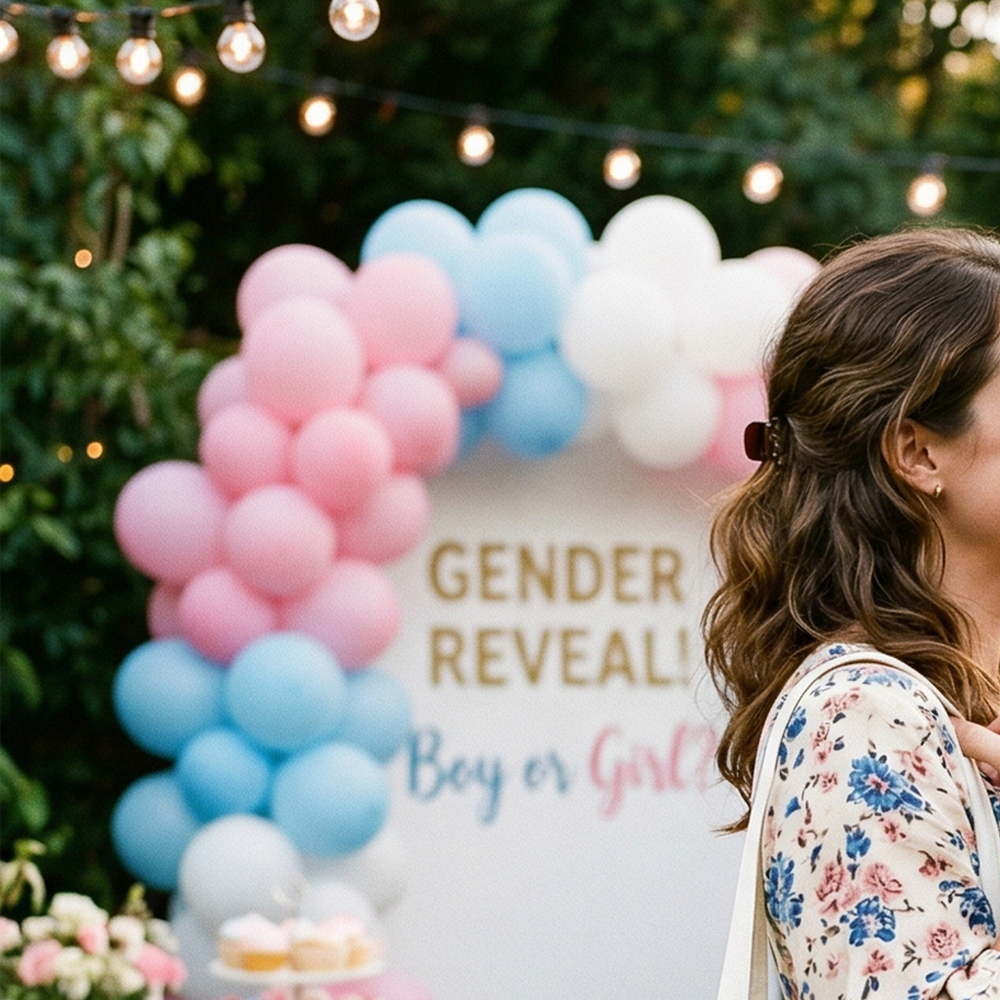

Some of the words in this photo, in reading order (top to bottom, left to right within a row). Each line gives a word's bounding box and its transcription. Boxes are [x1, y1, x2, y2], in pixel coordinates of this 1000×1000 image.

[428, 540, 689, 605] GENDER
[429, 626, 690, 689] REVEAL!
[403, 726, 504, 827] Boy
[523, 748, 571, 795] or
